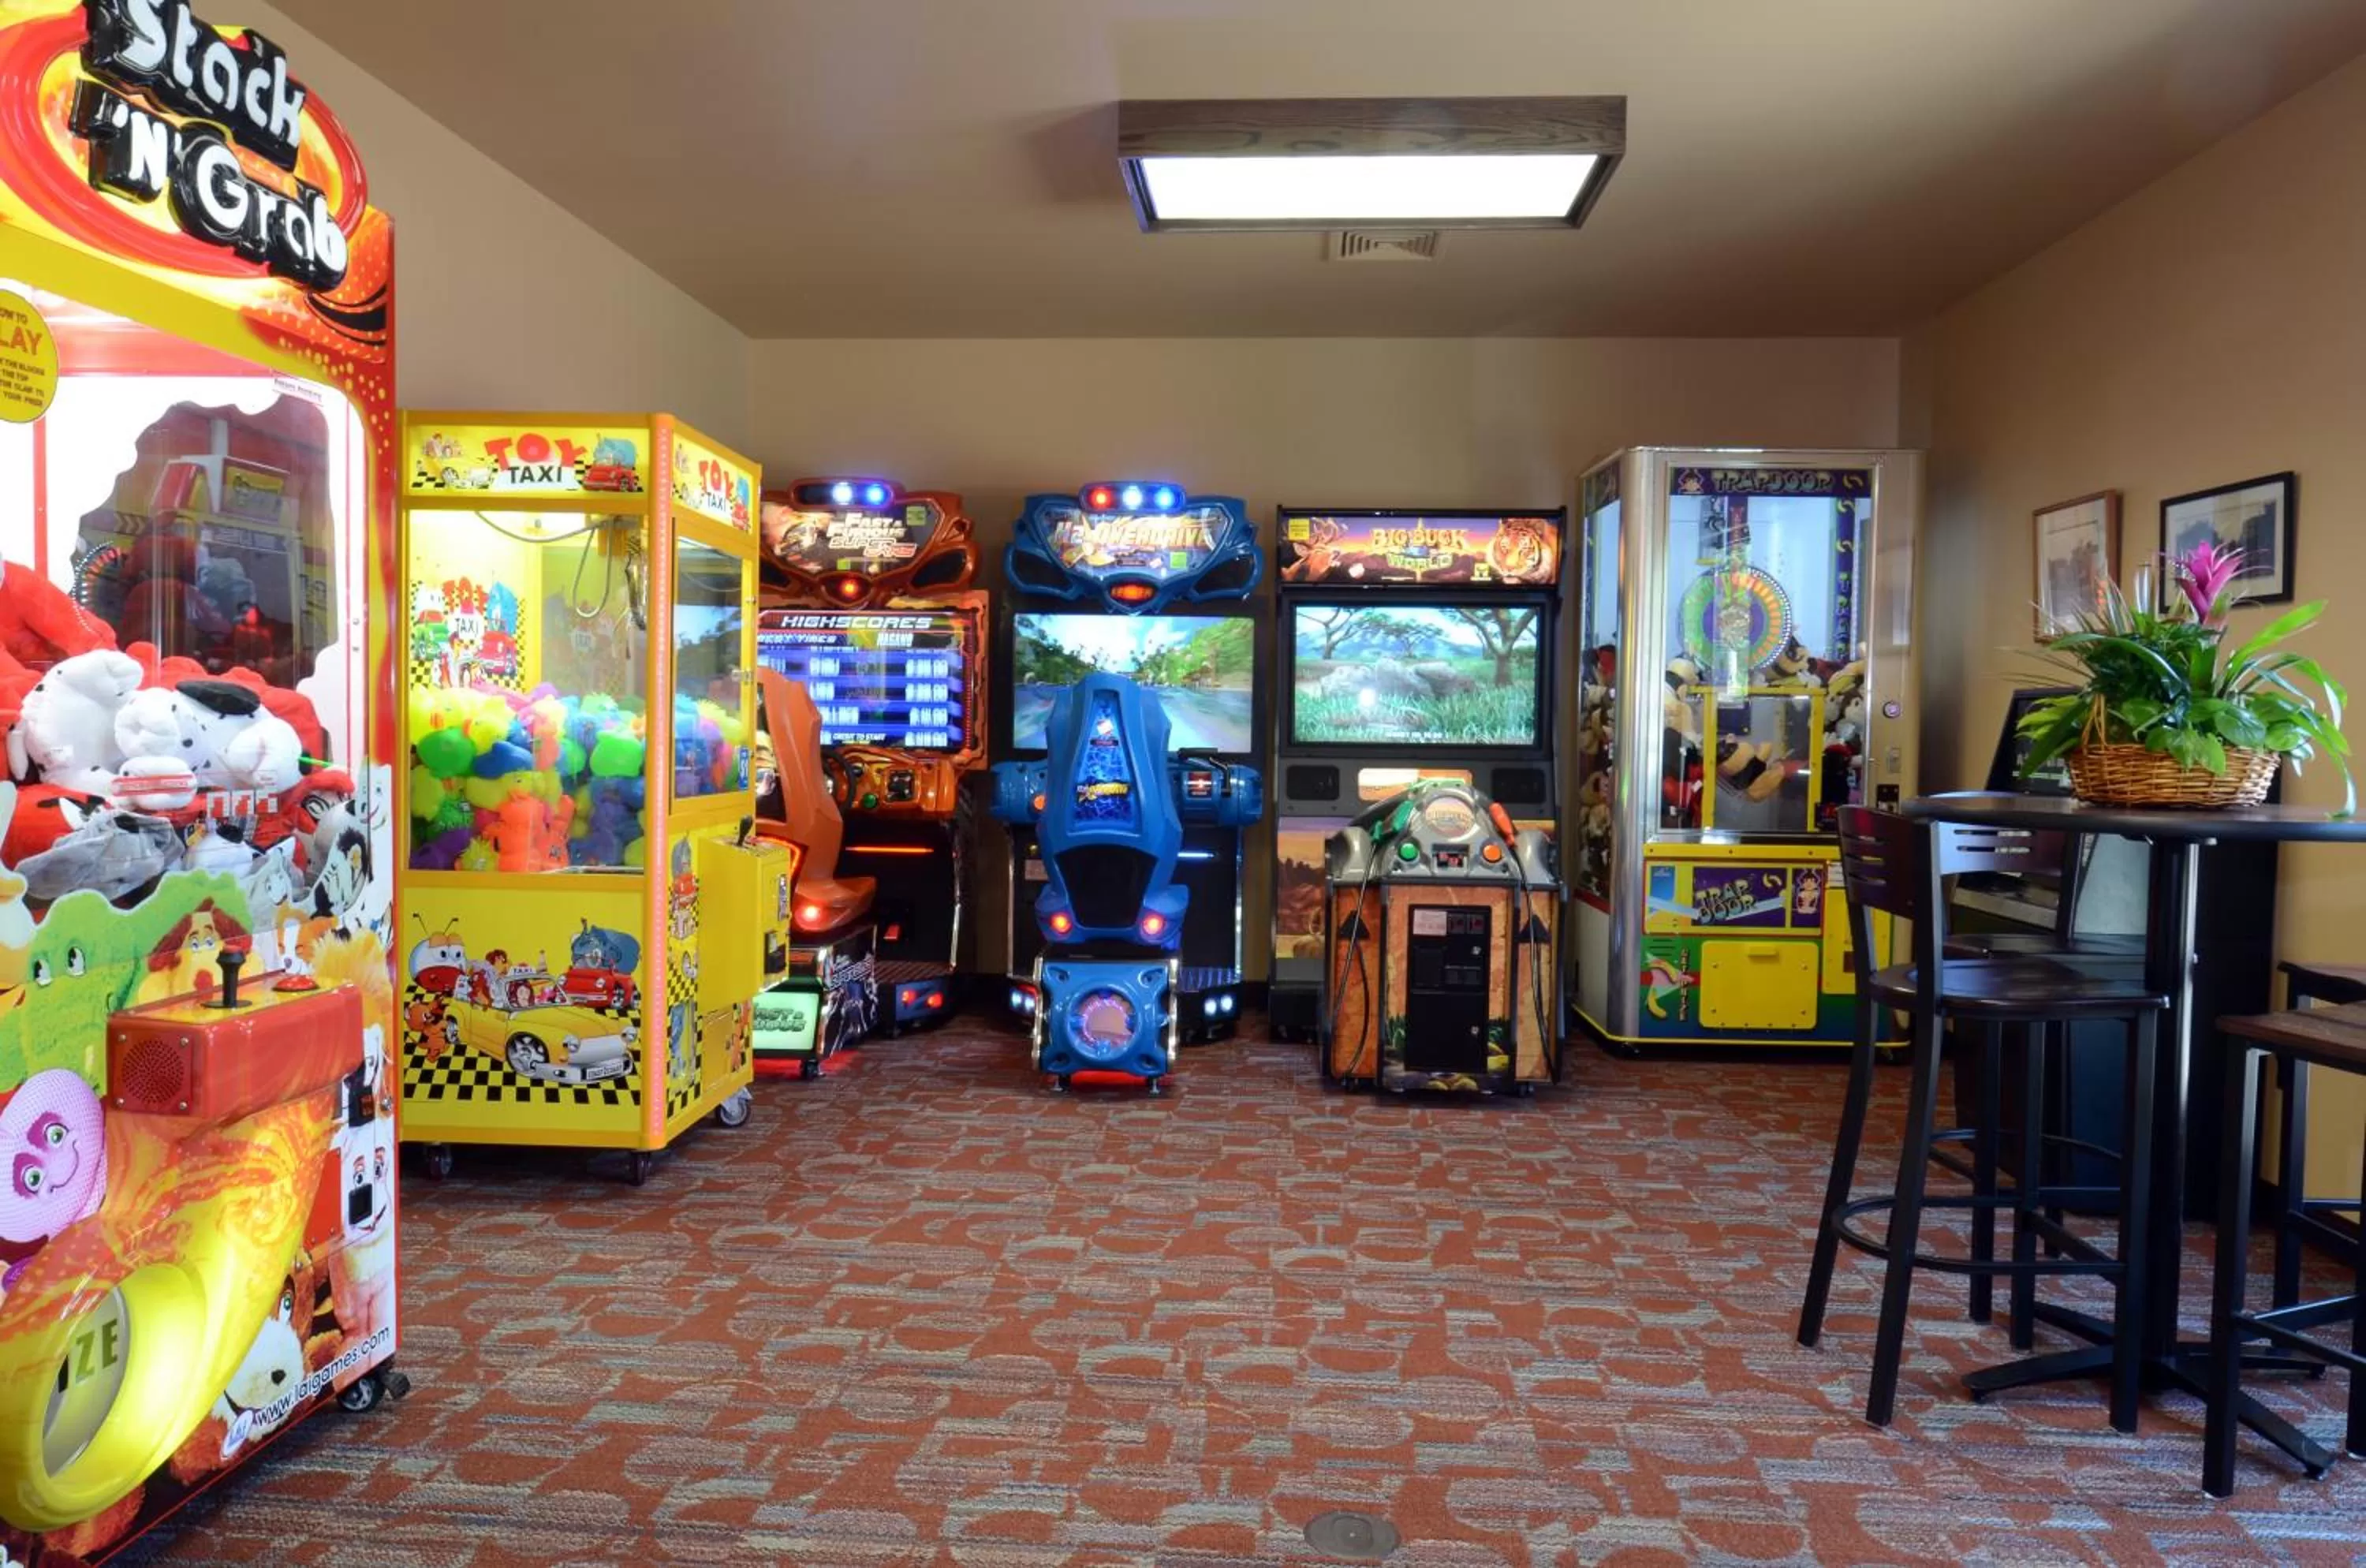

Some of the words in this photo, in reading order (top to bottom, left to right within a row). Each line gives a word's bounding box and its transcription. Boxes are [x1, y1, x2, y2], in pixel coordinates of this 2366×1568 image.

[122, 0, 306, 147] Stack
[196, 144, 349, 274] Grab
[484, 433, 587, 471] TOY
[508, 466, 562, 483] TAXI
[699, 460, 734, 500] TOY
[707, 491, 726, 512] TAXI
[1370, 528, 1409, 549] BIG
[1410, 528, 1469, 551] BUCK
[455, 618, 479, 634] TAXI
[781, 616, 933, 629] HIGHSCORES
[1696, 879, 1750, 911] TRAP
[1699, 894, 1759, 924] DOOR
[58, 1318, 118, 1394] IZE
[256, 1327, 390, 1426] www.laigames.com
